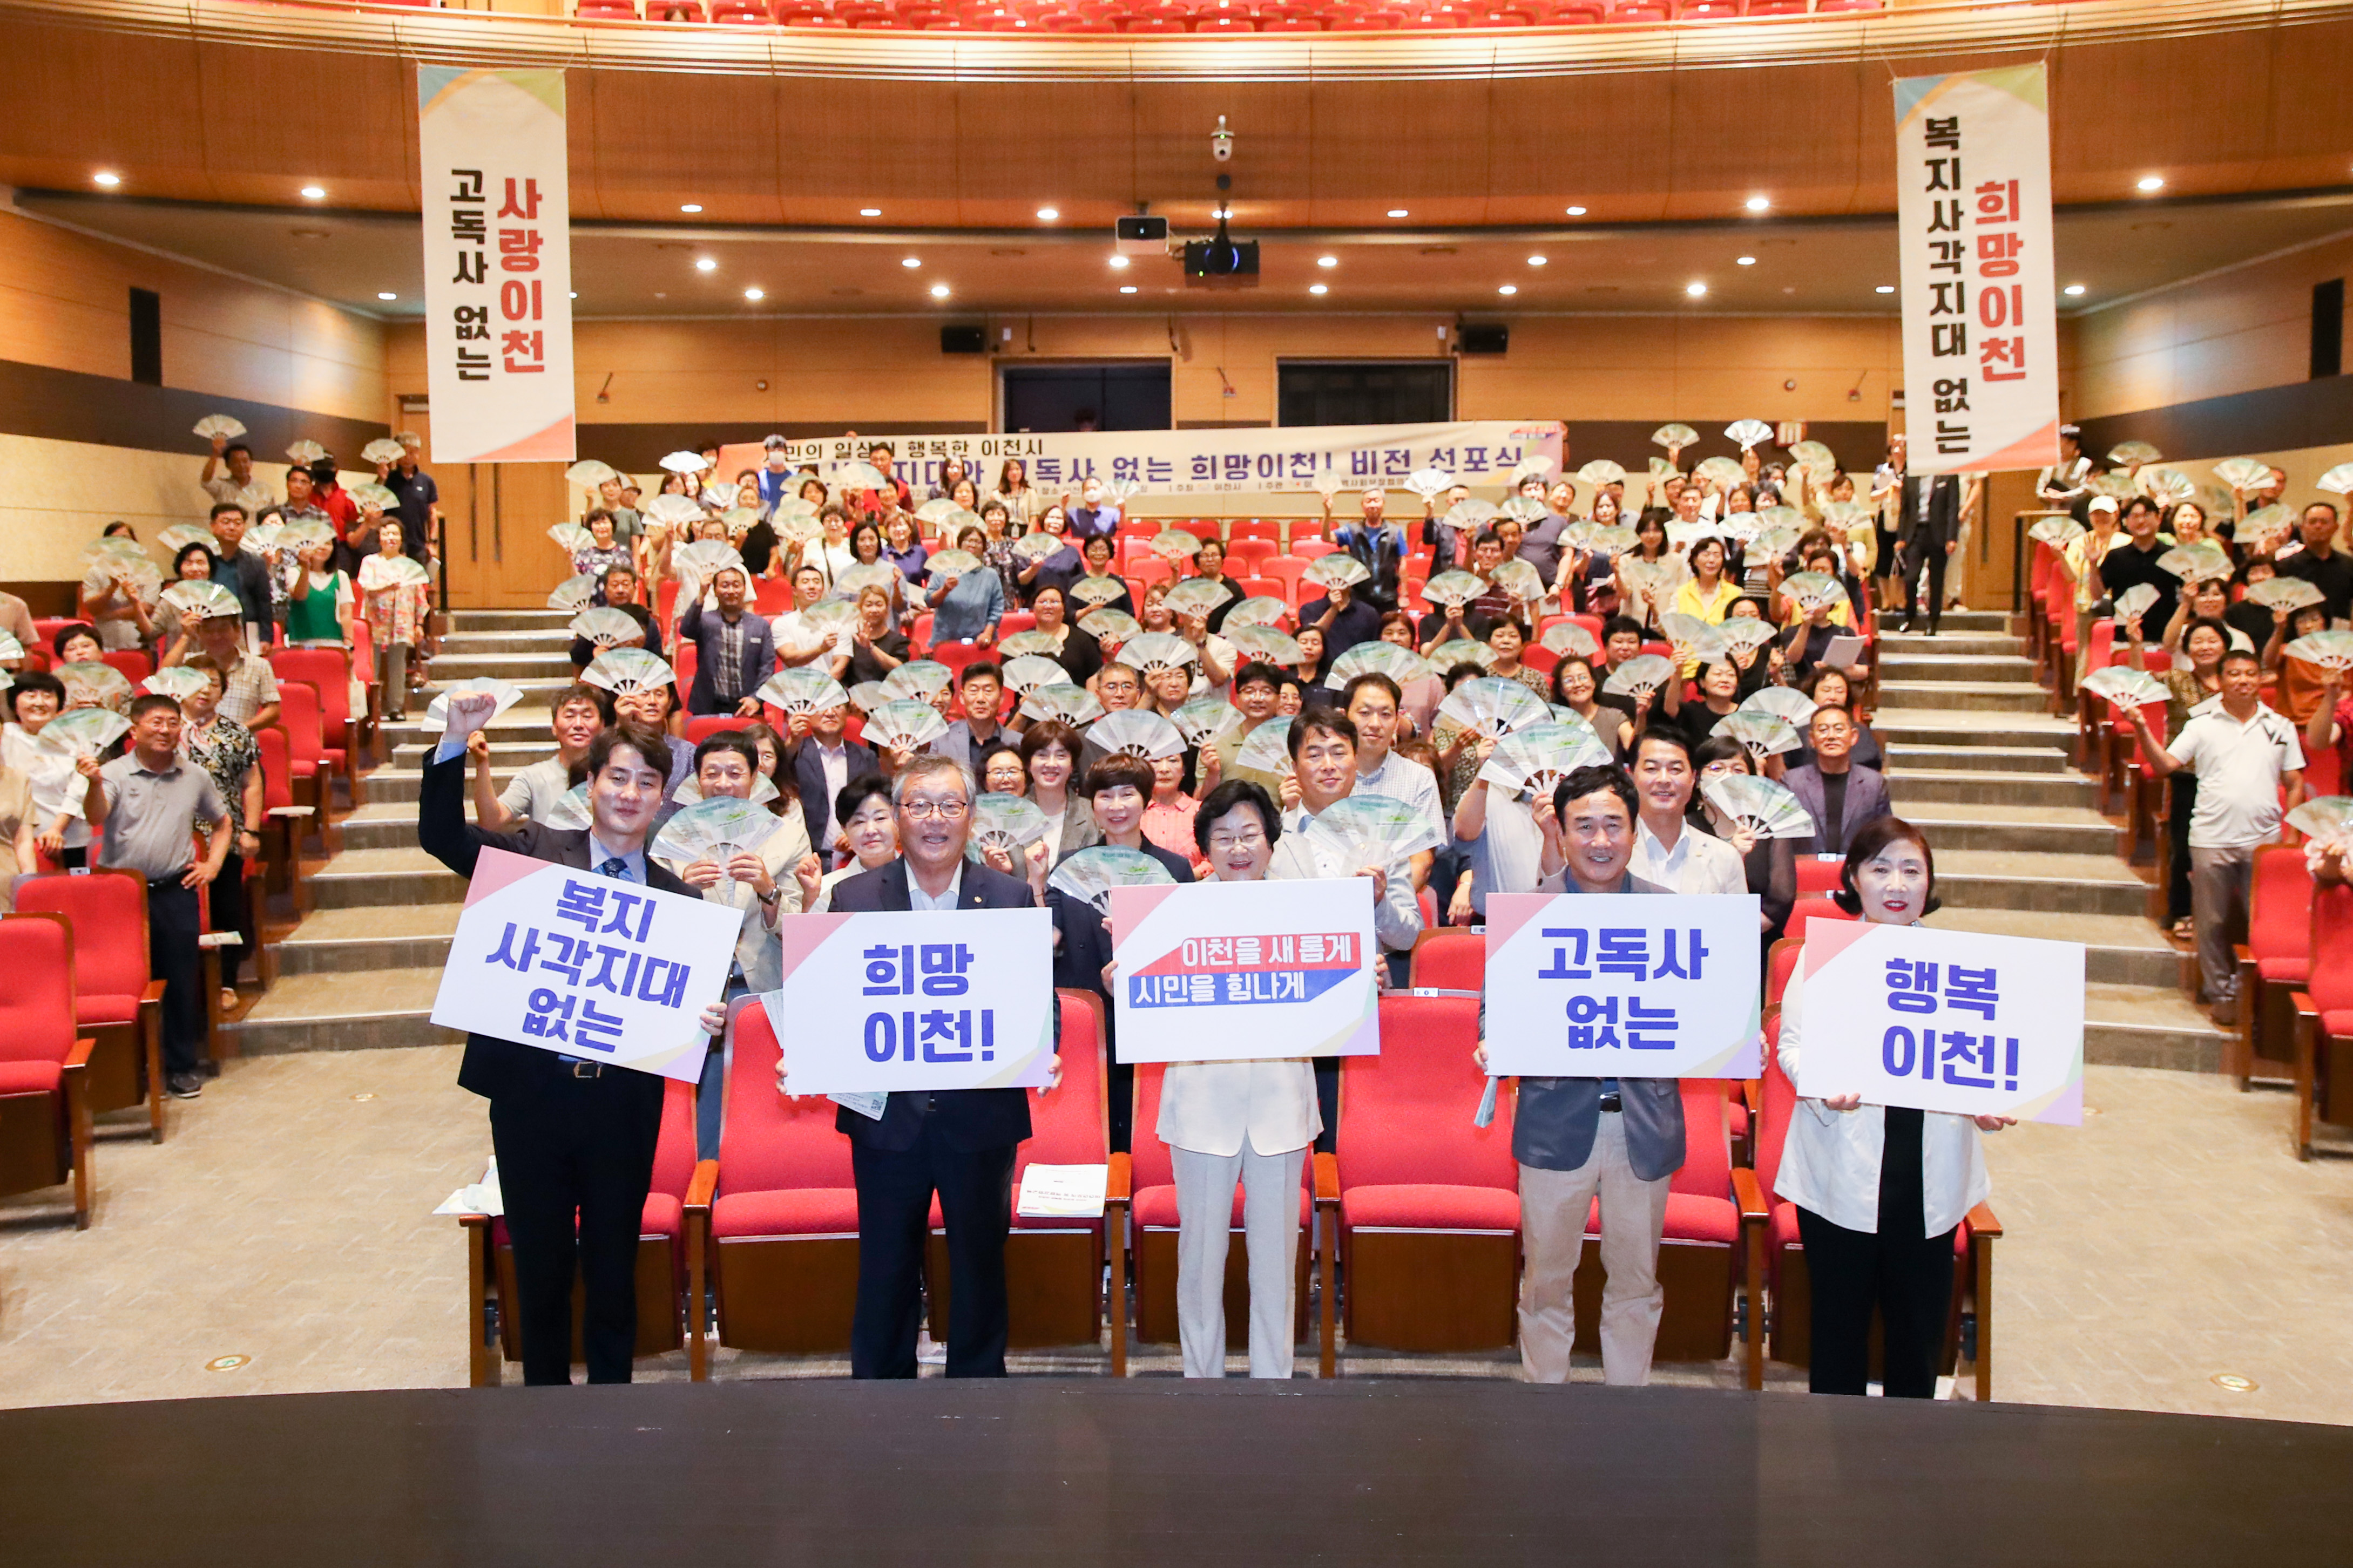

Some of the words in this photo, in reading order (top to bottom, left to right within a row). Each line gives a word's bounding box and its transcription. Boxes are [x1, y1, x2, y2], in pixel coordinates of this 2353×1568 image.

[450, 169, 488, 284] 고독사
[1924, 116, 1967, 357] 복지사각지대
[497, 178, 545, 373] 사랑이천
[1975, 179, 2026, 382] 희망이천
[454, 306, 491, 381] 없는
[1933, 378, 1971, 453] 없는
[908, 439, 969, 458] 행복한
[981, 438, 1043, 457] 이천시
[1191, 451, 1331, 480] 희망이천!
[1351, 449, 1411, 476] 비전
[1429, 446, 1522, 474] 선포식
[556, 879, 657, 943] 복지
[485, 922, 691, 1009] 사각지대
[863, 943, 974, 996] 희망
[1181, 936, 1262, 967] 이천을
[1268, 934, 1352, 964] 새롭게
[1538, 928, 1709, 982] 고독사
[1135, 974, 1216, 1005] 시민을
[1226, 970, 1306, 1002] 힘나게
[1886, 958, 1999, 1021] 행복
[522, 988, 624, 1053] 없는
[864, 1009, 995, 1063] 이천!
[1566, 995, 1679, 1050] 없는
[1883, 1026, 2019, 1091] 이천!
